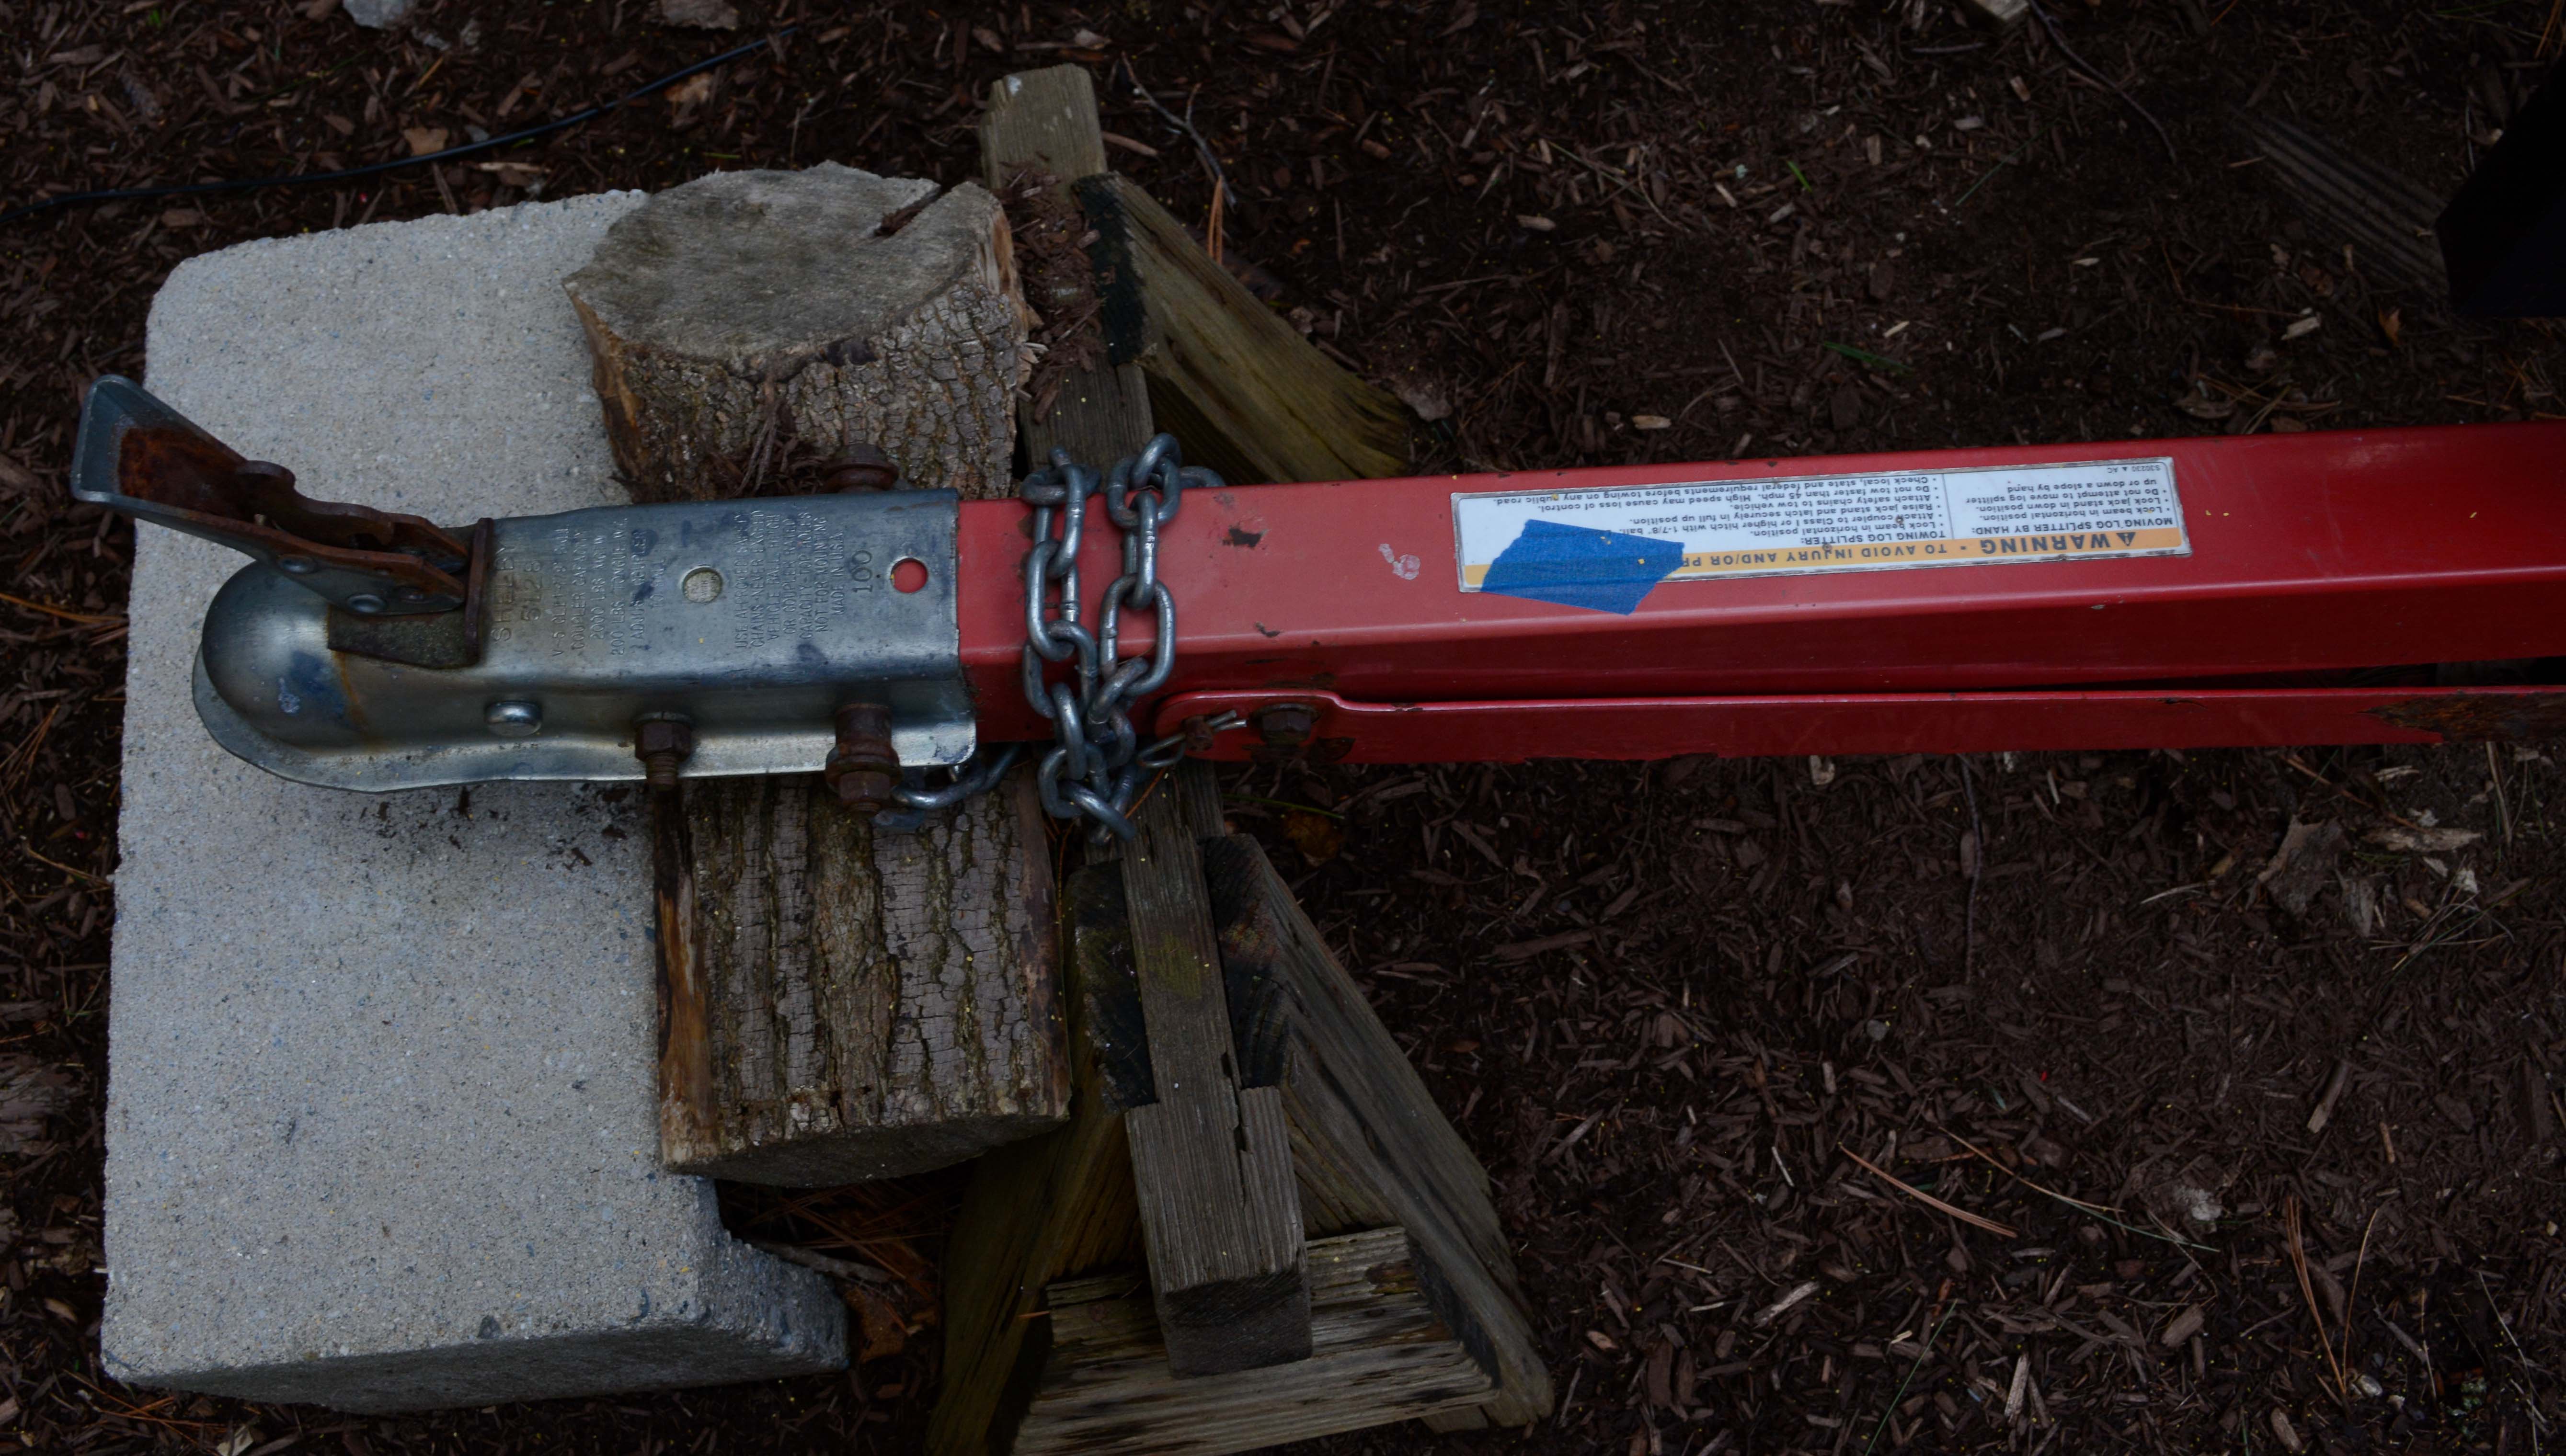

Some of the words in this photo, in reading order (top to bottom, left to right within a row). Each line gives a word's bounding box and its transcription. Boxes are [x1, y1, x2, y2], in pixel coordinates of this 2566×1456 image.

[1803, 481, 1824, 489] and
[1859, 478, 1890, 487] local,
[1893, 476, 1928, 485] Check
[1683, 485, 1758, 495] requirements
[1761, 483, 1801, 492] federal
[1833, 488, 1867, 496] faster
[2006, 485, 2035, 494] hand
[1603, 491, 1641, 500] towing
[1644, 489, 1681, 497] before
[1757, 492, 1786, 500] mph.
[1788, 491, 1802, 500] 45
[1805, 490, 1830, 498] than
[2076, 490, 2119, 499] attempt
[1493, 498, 1522, 506] road.
[1687, 495, 1722, 505] speed
[1724, 494, 1751, 503] High
[1815, 498, 1853, 507] chains
[1856, 496, 1890, 504] safety
[1893, 494, 1931, 503] Attach
[1965, 495, 2006, 504] splitter
[2106, 498, 2131, 507] jack
[2133, 497, 2161, 505] Lock
[1537, 503, 1581, 513] control.
[1584, 502, 1595, 511] of
[1730, 502, 1774, 511] vehicle.
[1874, 504, 1899, 513] jack
[1901, 503, 1933, 511] Raise
[1975, 503, 2024, 513] position.
[2072, 500, 2104, 509] stand
[1784, 509, 1813, 518] latch
[1816, 508, 1837, 516] and
[1840, 506, 1871, 515] stand
[2135, 506, 2163, 514] Lock
[1698, 514, 1717, 523] full
[1733, 511, 1782, 520] securely
[1851, 514, 1893, 523] coupler
[1979, 512, 2028, 522] position.
[2030, 510, 2086, 520] horizontal
[1629, 516, 1678, 525] position.
[1741, 520, 1777, 529] higher
[1802, 517, 1834, 525] Class
[2095, 520, 2120, 529] LOG
[2124, 517, 2173, 527] MOVING
[798, 512, 812, 547] HOLES
[1681, 524, 1707, 533] with
[1709, 522, 1739, 531] hitch
[1801, 525, 1858, 535] horizontal
[1908, 521, 1936, 530] Lock
[1972, 525, 2010, 535] HAND:
[2014, 524, 2030, 533] BY
[2033, 521, 2092, 532] SPLITTER
[750, 510, 765, 552] EXCEED
[766, 514, 780, 547] HITCH
[1750, 528, 1798, 537] position.
[1895, 530, 1946, 540] TOWING
[782, 518, 796, 554] RATED
[1800, 534, 1864, 545] SPLITTER:
[1866, 533, 1892, 542] LOG
[813, 516, 828, 574] MOUNTING
[1980, 534, 2110, 554] WARNING
[1861, 546, 1914, 557] AVOID
[1925, 544, 1946, 554] TO
[1710, 553, 1776, 565] AND/OR
[1787, 549, 1851, 561] INJURY
[830, 566, 844, 576] IN
[851, 550, 873, 592] 100
[734, 558, 748, 618] APPROVED
[782, 560, 796, 612] COUPLER
[814, 580, 828, 603] FOR
[830, 585, 844, 614] MADE
[570, 592, 586, 650] COUPLER
[766, 593, 780, 640] VEHICLE
[814, 610, 828, 632] NOT
[590, 606, 605, 639] 2000
[782, 618, 796, 634] OR
[734, 625, 748, 648] USE
[610, 631, 624, 655] 200
